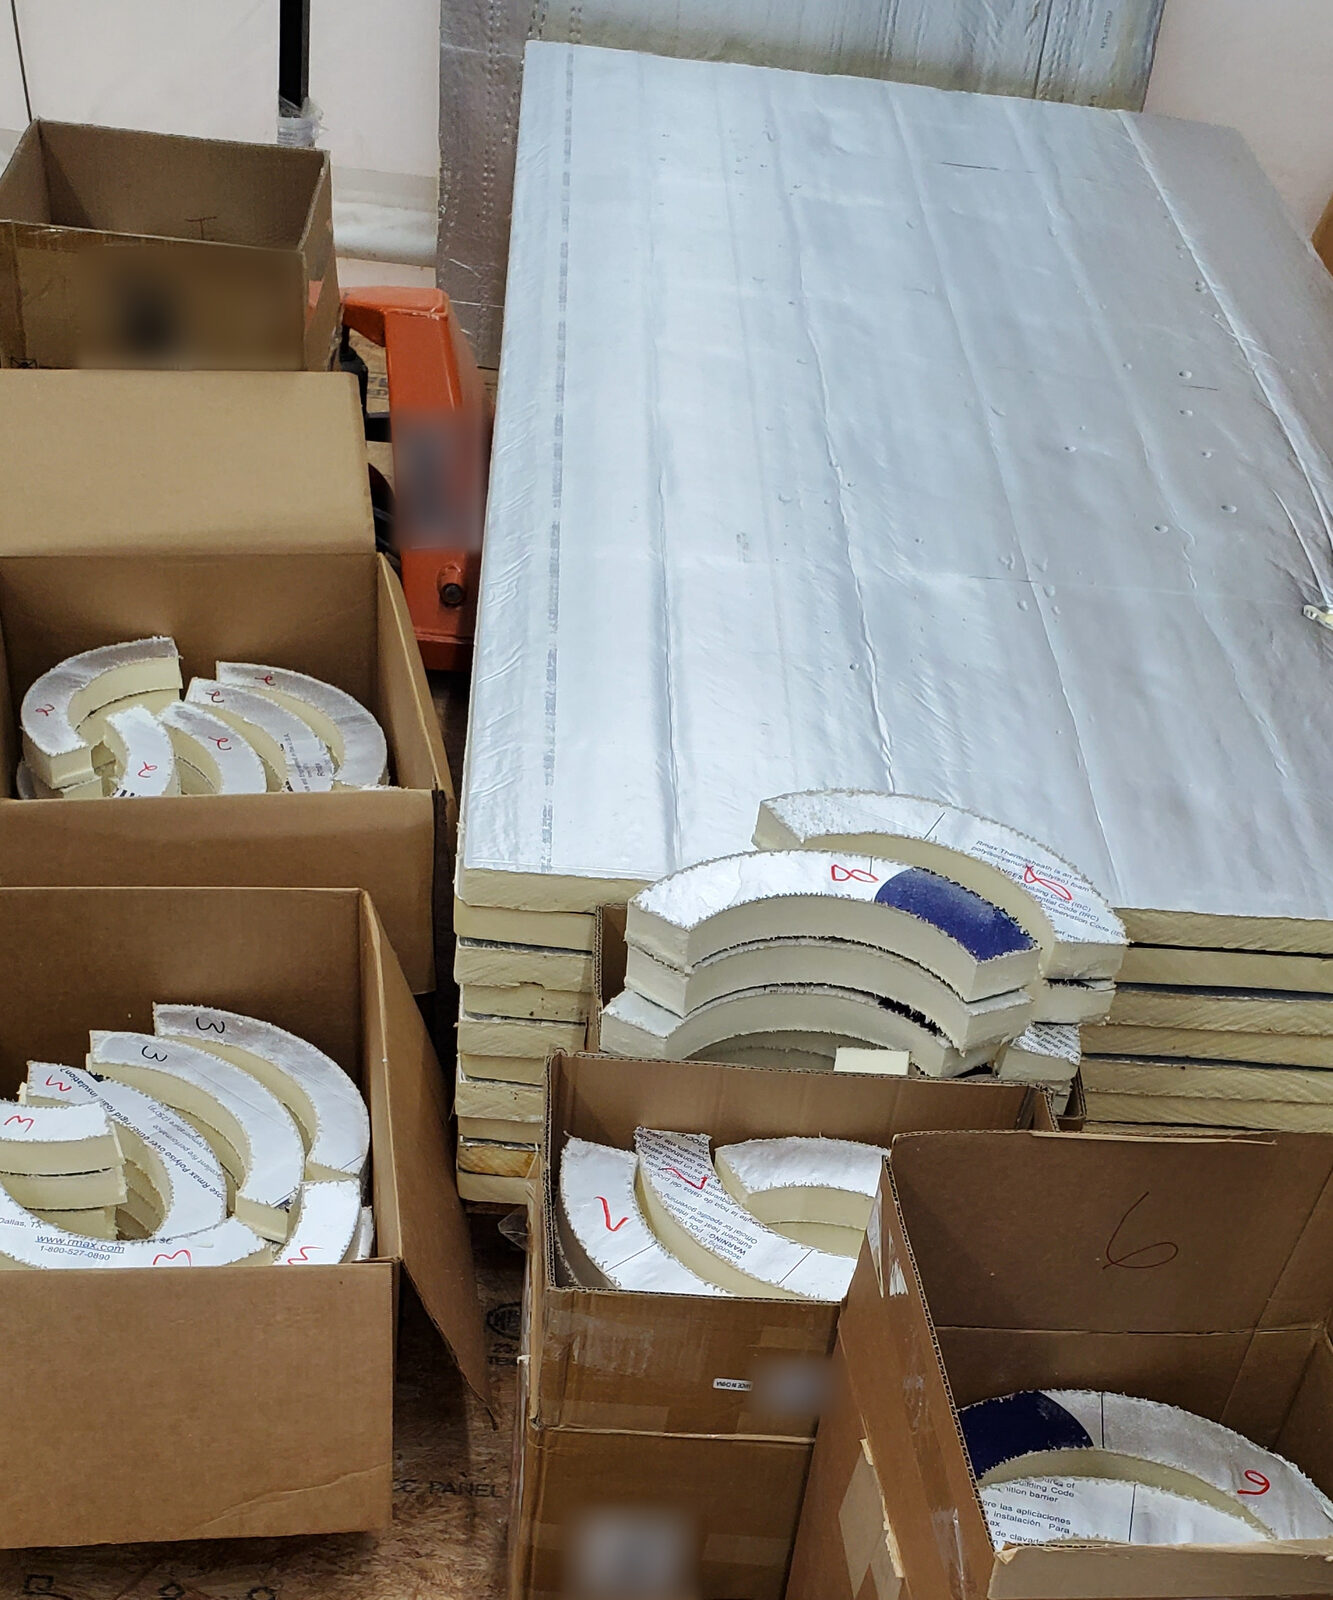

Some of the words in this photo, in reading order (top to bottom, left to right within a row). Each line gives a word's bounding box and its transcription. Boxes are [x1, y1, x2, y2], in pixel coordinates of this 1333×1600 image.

[976, 840, 997, 851] Rmax
[1058, 903, 1078, 914] Code
[1041, 903, 1088, 925] Conservation
[1089, 921, 1110, 932] Code
[60, 1067, 98, 1098] insulation?
[149, 1141, 165, 1154] over
[165, 1151, 189, 1172] Polyiso
[191, 1172, 210, 1189] Rmax
[664, 1193, 697, 1213] governing
[690, 1215, 703, 1224] and
[697, 1211, 723, 1226] specific
[704, 1223, 721, 1233] heat
[734, 1228, 758, 1245] Official
[1103, 1191, 1179, 1270] 6
[35, 1234, 125, 1253] www.rmax.com
[707, 1232, 746, 1256] WARNING:
[722, 1230, 752, 1250] sufficient
[40, 1245, 110, 1261] 1-800-527-0890
[1029, 1492, 1058, 1503] barrier
[1051, 1486, 1074, 1498] Code
[1000, 1503, 1013, 1512] las
[1016, 1507, 1071, 1526] aplicaciones
[1048, 1523, 1070, 1534] Para
